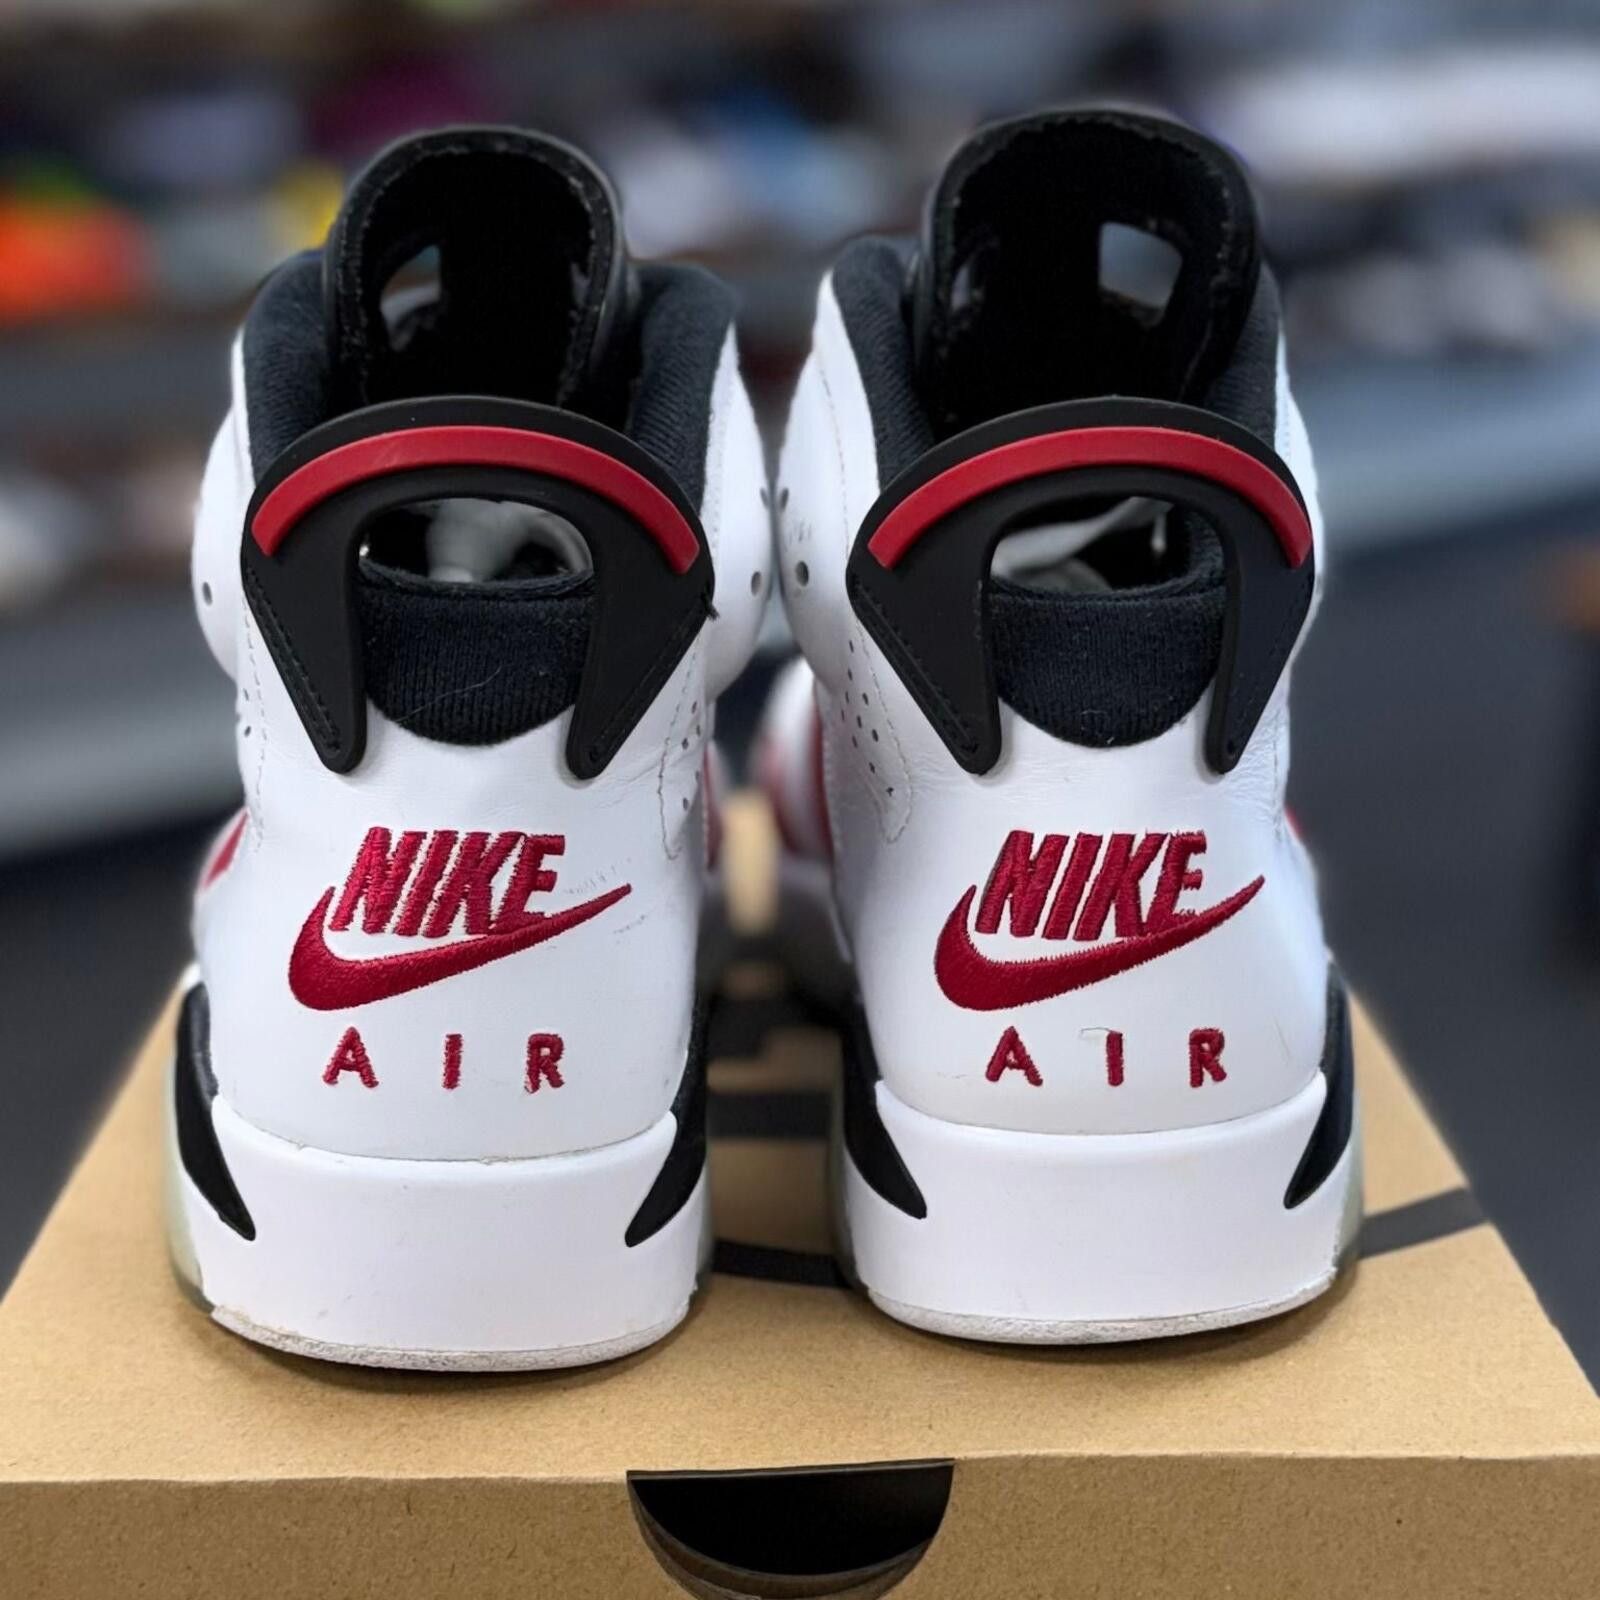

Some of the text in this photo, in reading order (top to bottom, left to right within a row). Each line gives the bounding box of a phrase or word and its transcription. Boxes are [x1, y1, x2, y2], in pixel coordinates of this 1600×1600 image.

[328, 826, 565, 938] NIKE
[975, 829, 1207, 941] NIKE
[322, 1026, 565, 1093] AIR
[985, 1026, 1227, 1088] AIR
